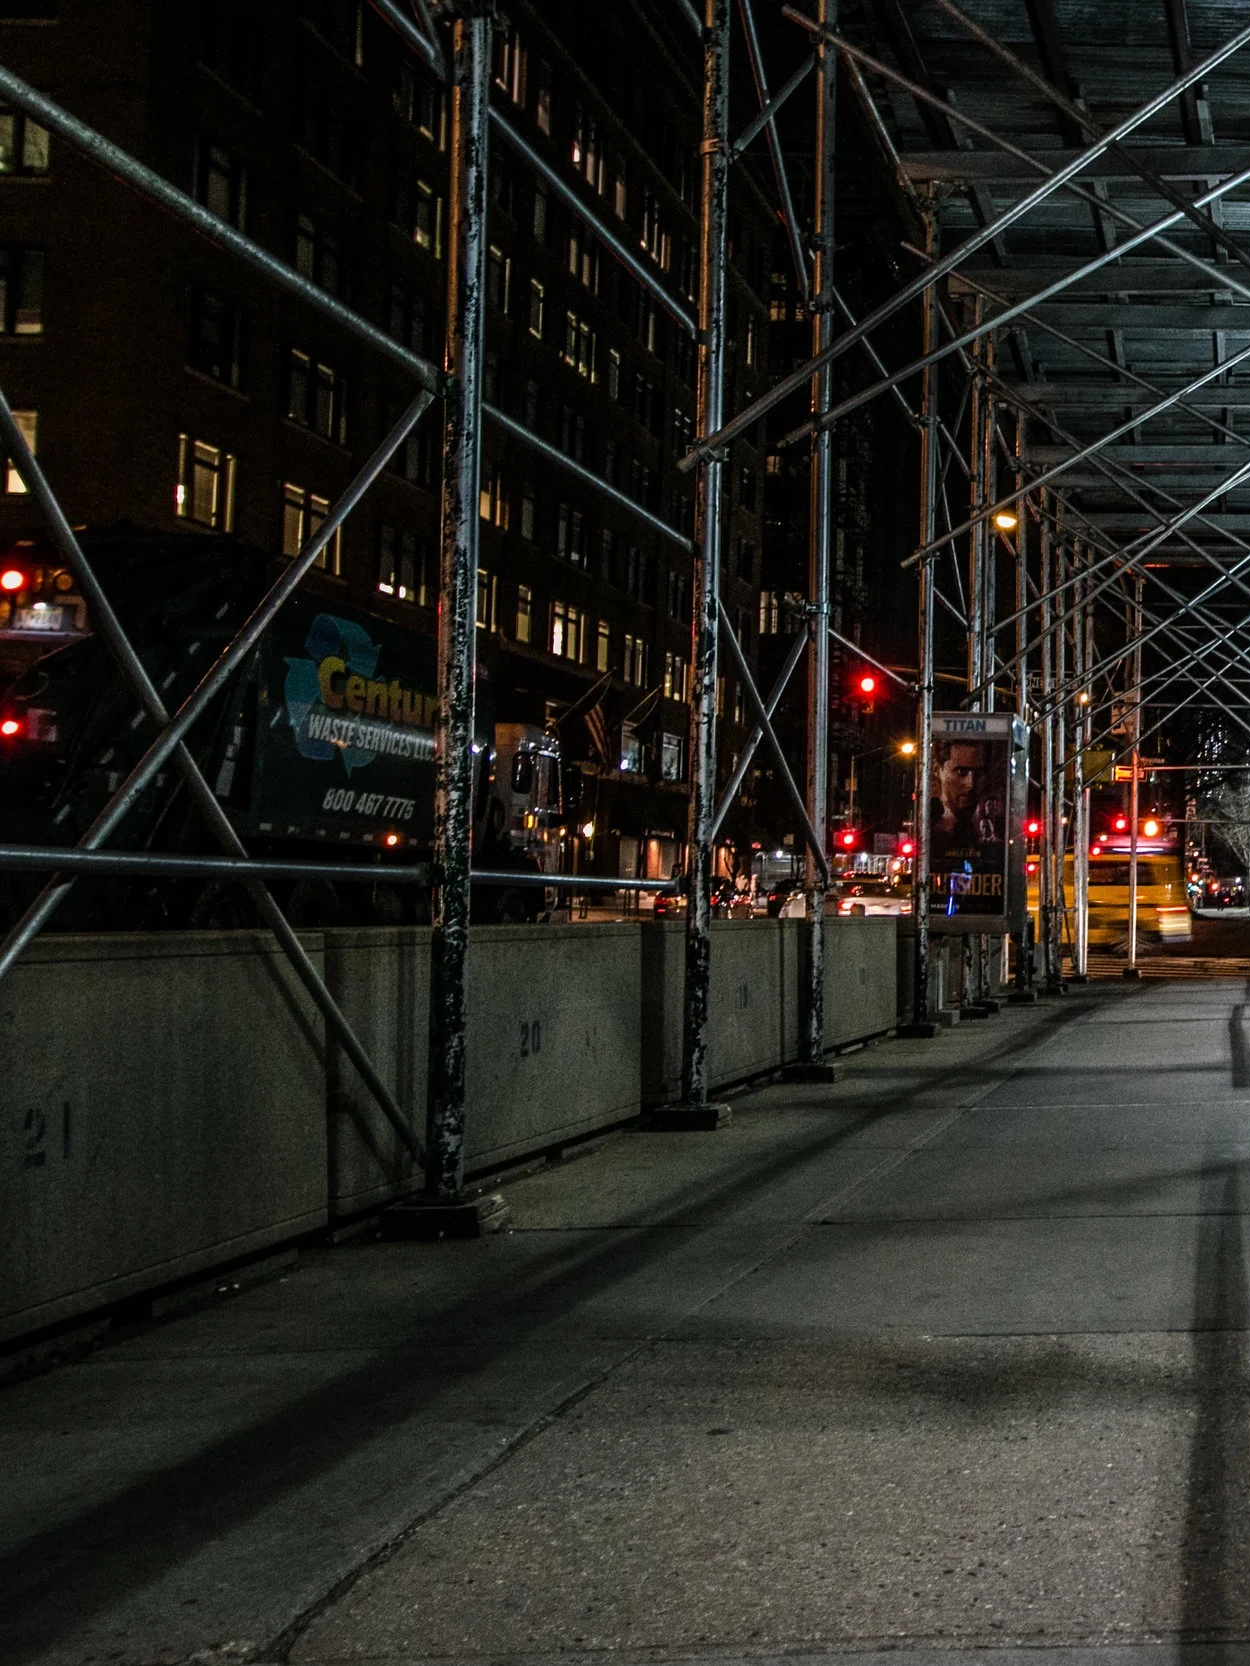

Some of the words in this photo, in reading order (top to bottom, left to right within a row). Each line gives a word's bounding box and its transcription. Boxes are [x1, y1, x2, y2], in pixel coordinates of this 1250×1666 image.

[318, 655, 437, 728] Centur
[308, 713, 357, 746] WASTE
[356, 724, 412, 757] SERVICES
[944, 719, 985, 732] TITAN
[322, 787, 355, 812] 800
[355, 792, 385, 816] 467
[382, 796, 416, 820] 7775
[520, 1020, 540, 1057] 20
[24, 1101, 70, 1168] 21
